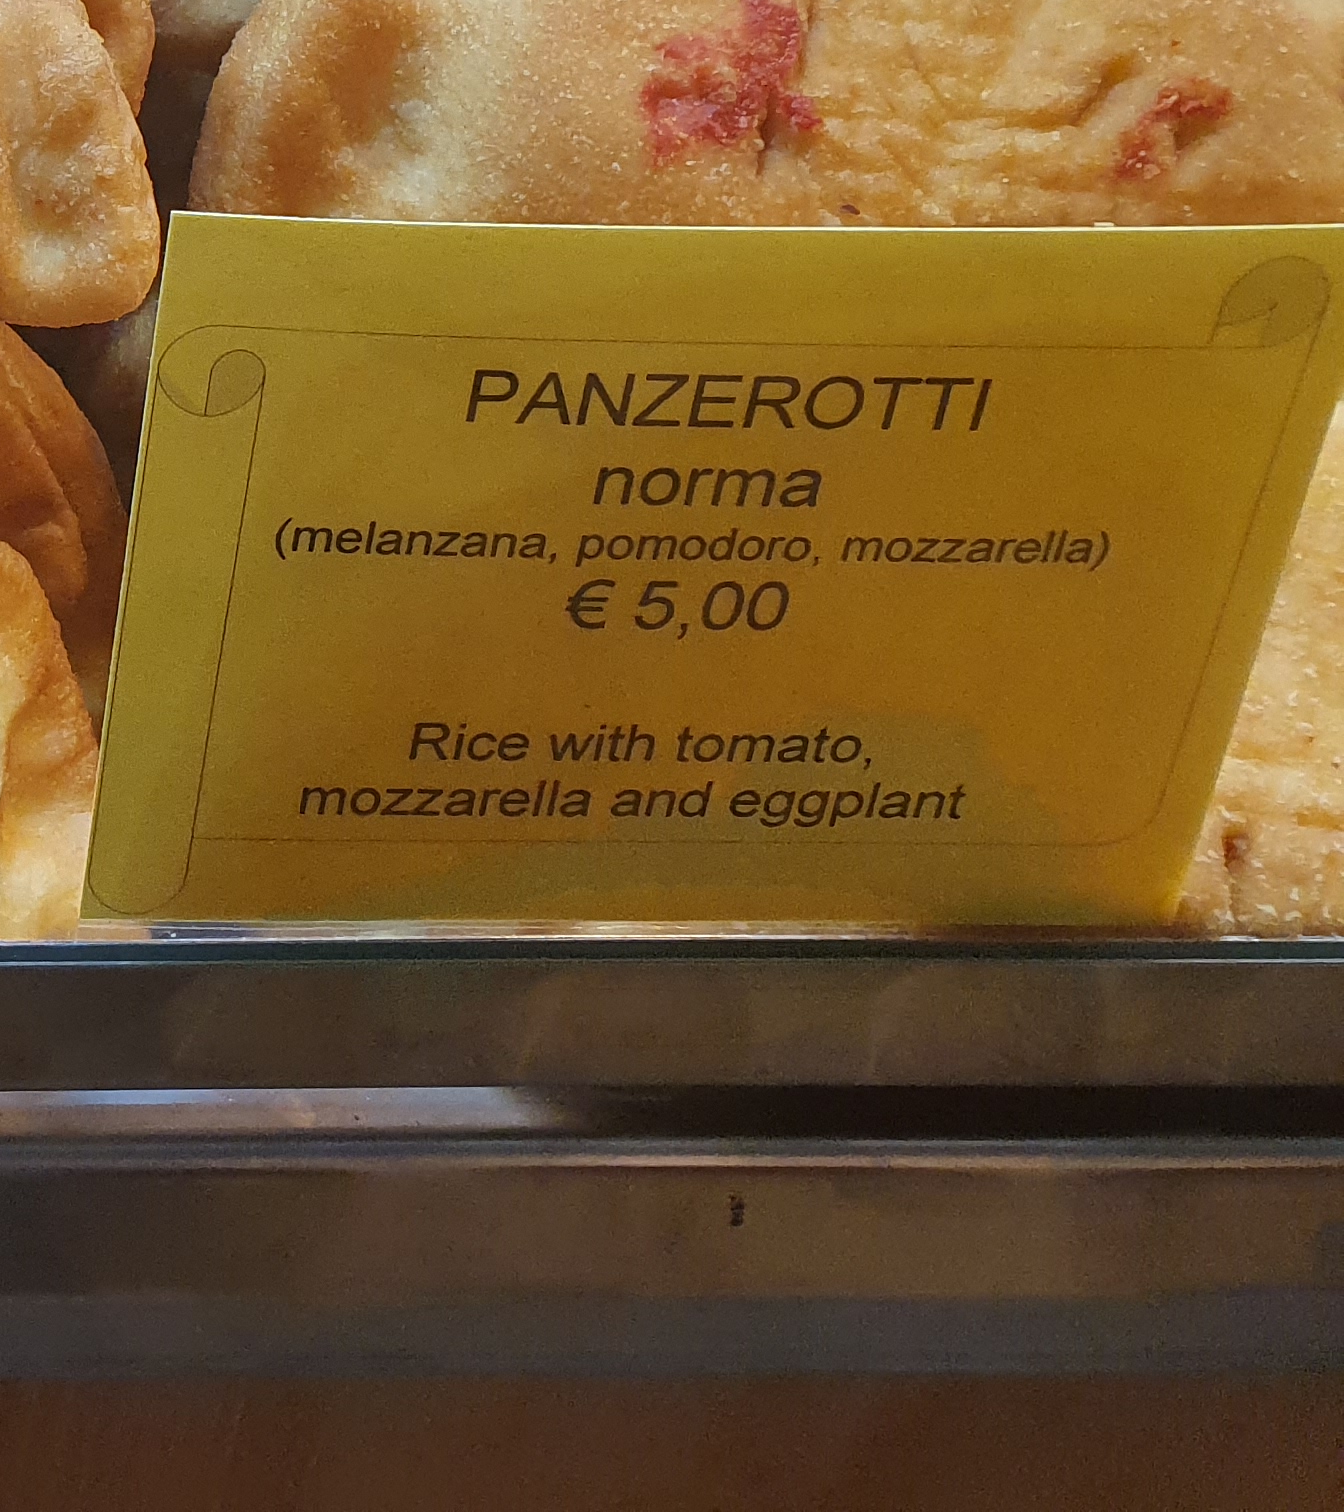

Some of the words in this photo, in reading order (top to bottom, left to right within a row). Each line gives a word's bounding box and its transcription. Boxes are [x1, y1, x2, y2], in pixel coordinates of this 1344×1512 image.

[465, 369, 993, 432] PANZEROTTI
[592, 466, 822, 508] norma
[275, 516, 557, 565] (melanzana,
[574, 527, 820, 568] pomodoro,
[840, 529, 1110, 572] mozzarella)
[564, 578, 616, 630] €
[634, 580, 790, 640] 5,00
[408, 722, 530, 762] Rice
[549, 723, 656, 763] with
[676, 726, 872, 771] tomato,
[299, 779, 592, 818] mozzarella
[610, 780, 714, 818] and
[728, 781, 967, 828] eggplant
